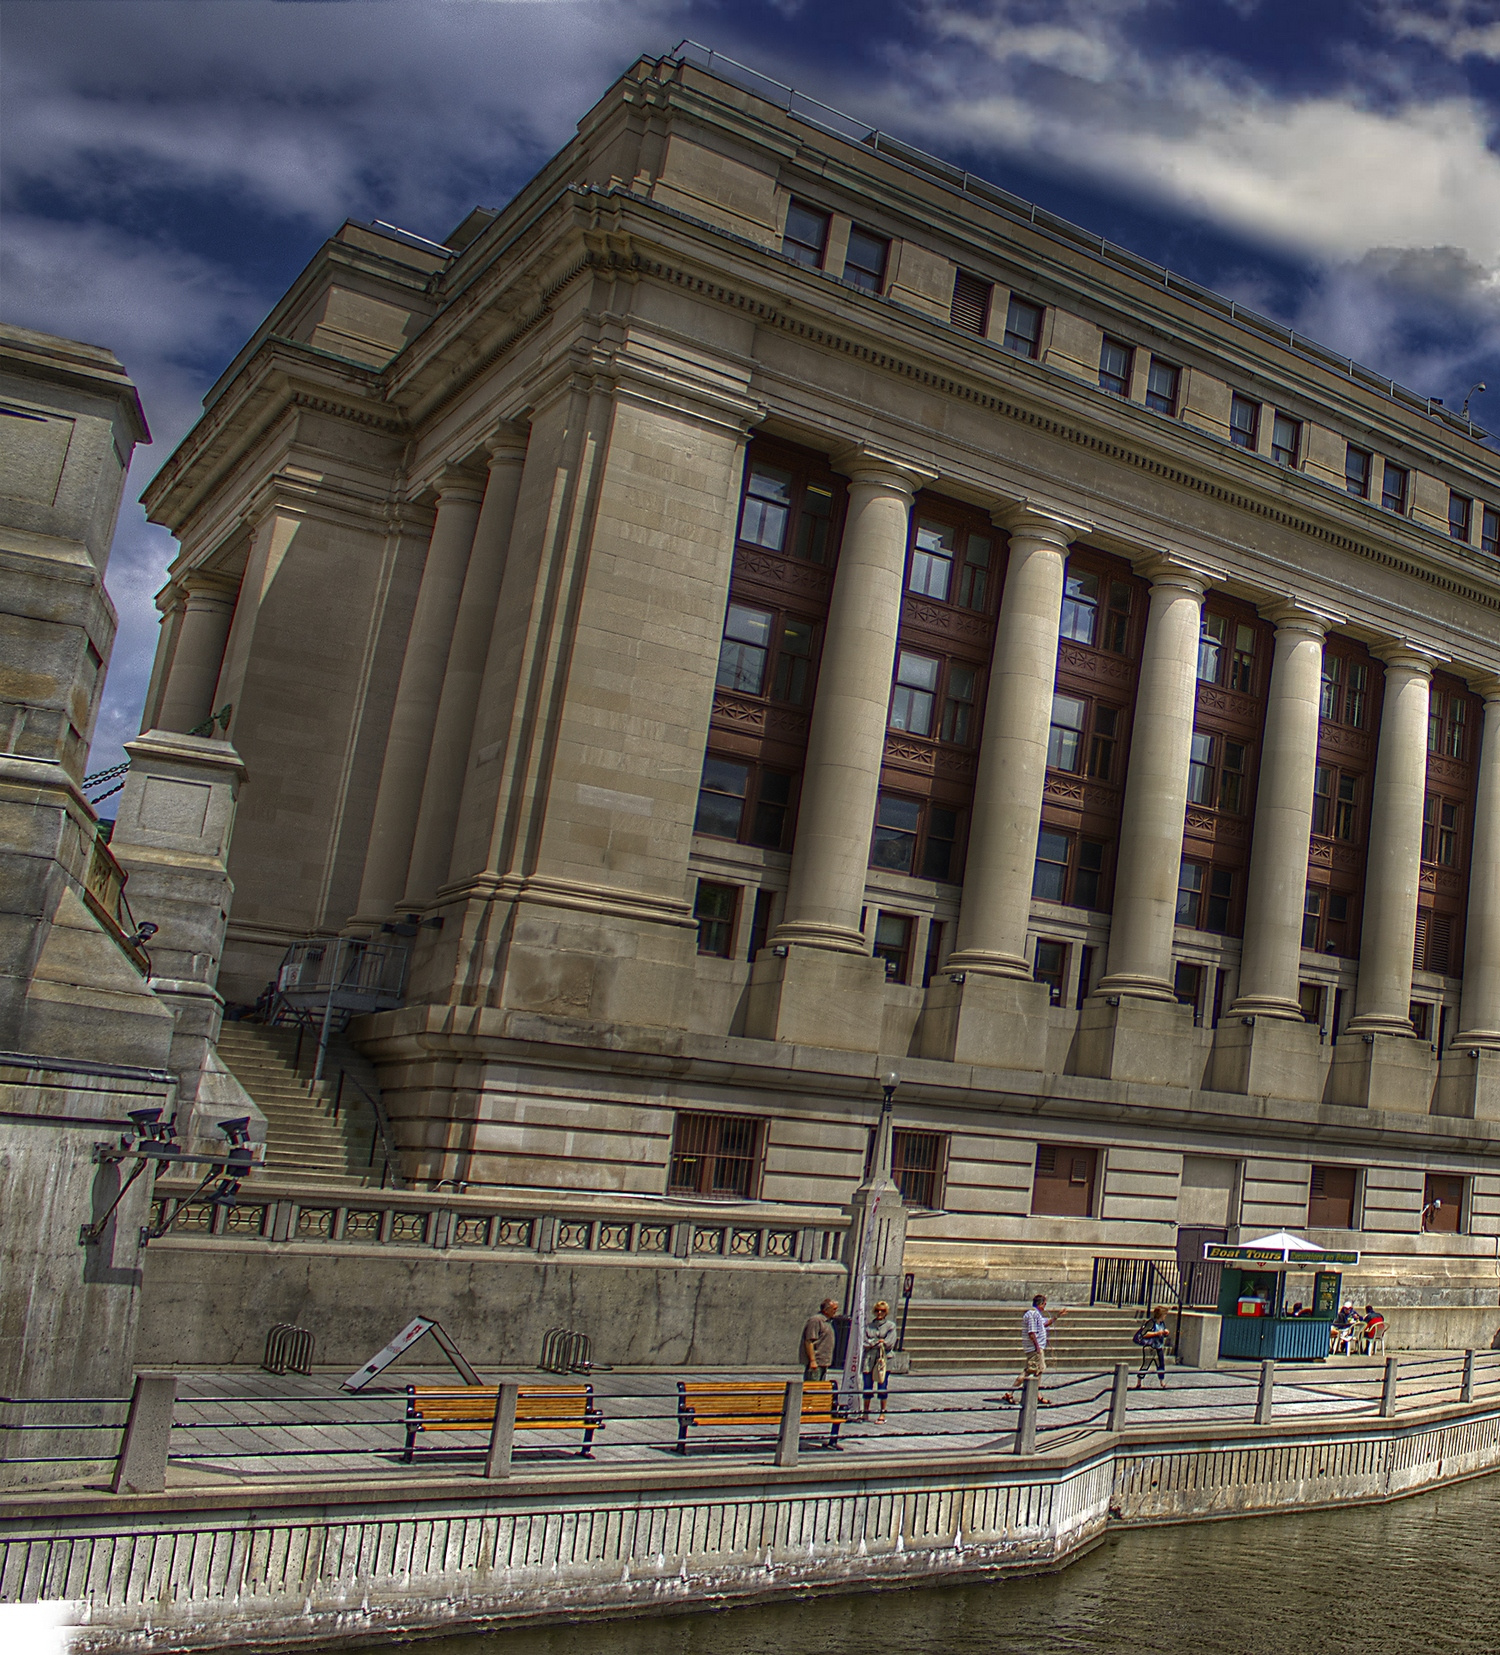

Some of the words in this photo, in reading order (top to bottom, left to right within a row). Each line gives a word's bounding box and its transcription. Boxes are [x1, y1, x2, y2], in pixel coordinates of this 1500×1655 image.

[1210, 1247, 1241, 1258] Boat
[1246, 1249, 1282, 1260] Tours
[1290, 1251, 1324, 1261] Excursions
